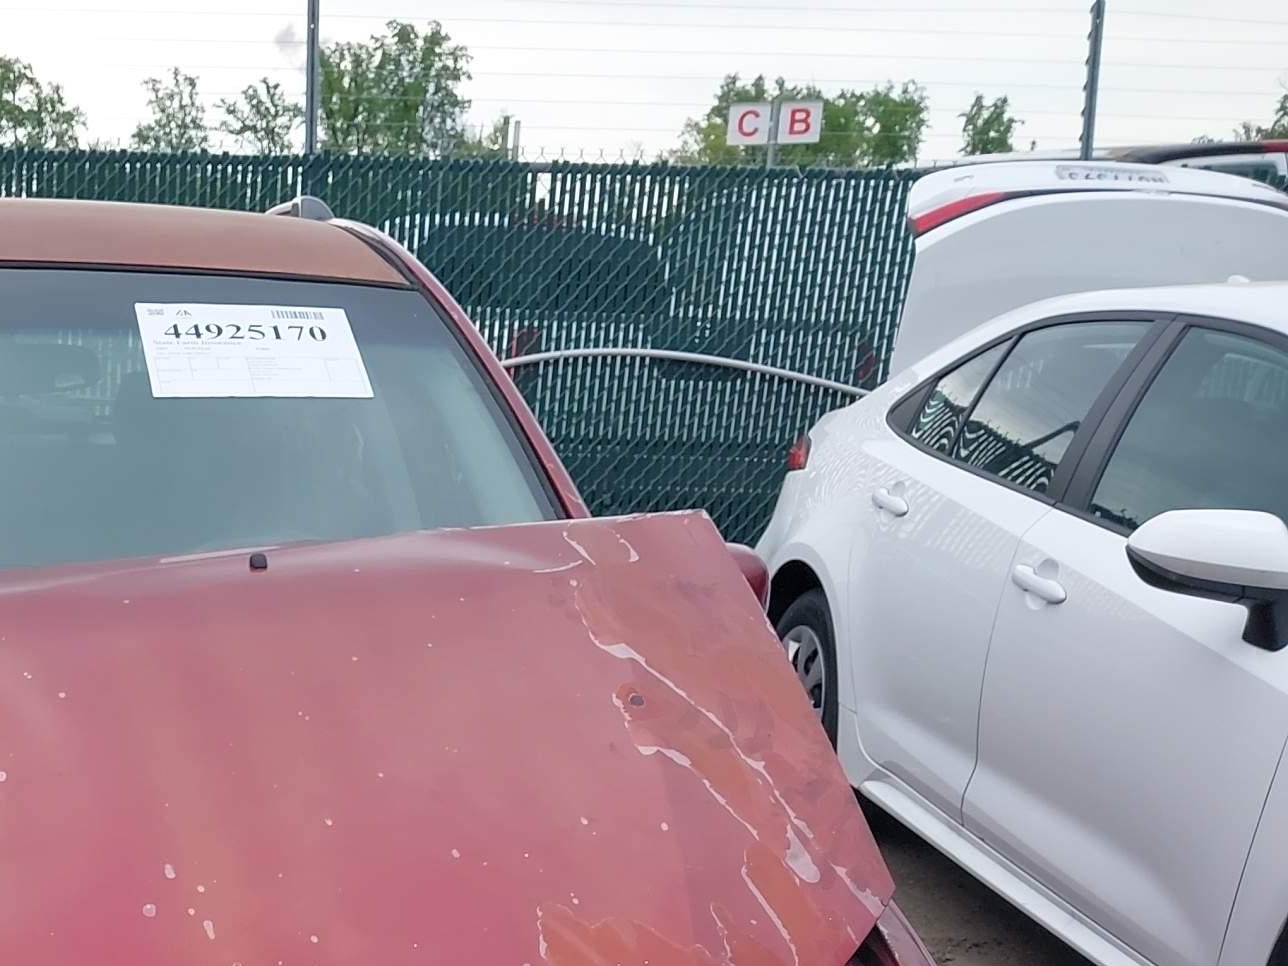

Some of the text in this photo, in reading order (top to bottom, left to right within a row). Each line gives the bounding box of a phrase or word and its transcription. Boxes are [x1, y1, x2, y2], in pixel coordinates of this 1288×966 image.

[738, 109, 760, 137] C
[789, 108, 811, 135] B
[164, 323, 327, 342] 44925170
